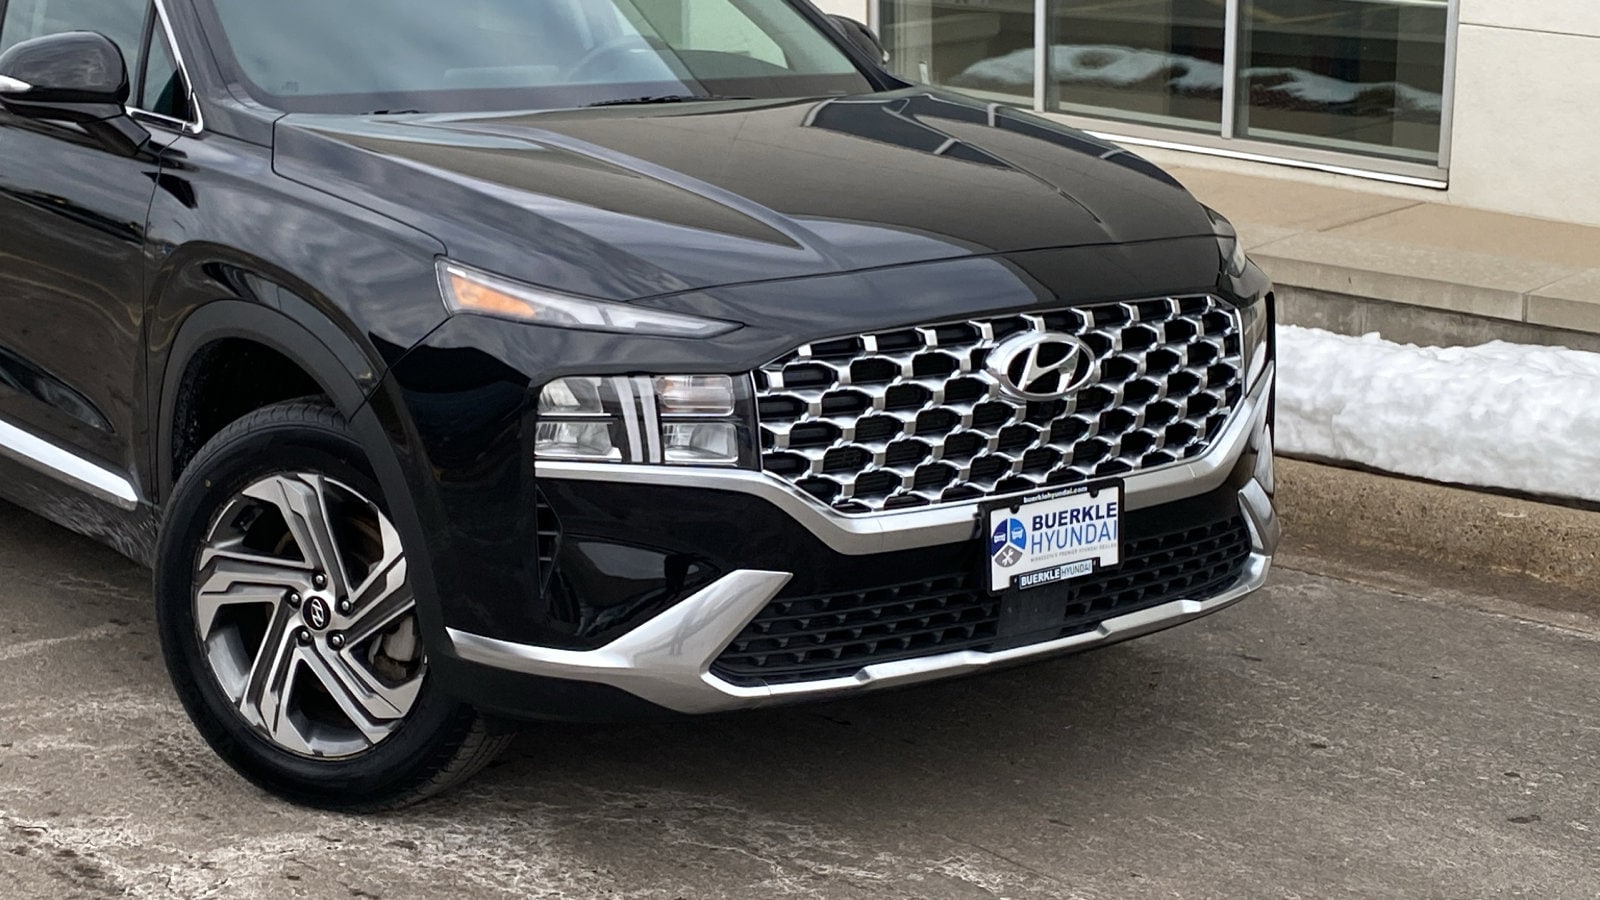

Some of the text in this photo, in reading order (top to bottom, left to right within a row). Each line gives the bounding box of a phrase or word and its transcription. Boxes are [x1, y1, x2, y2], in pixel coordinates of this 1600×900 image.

[1032, 501, 1117, 531] BUERKLE
[1031, 520, 1117, 554] HYUNDAI
[1021, 563, 1091, 587] BUERKLE HYUNDAI
